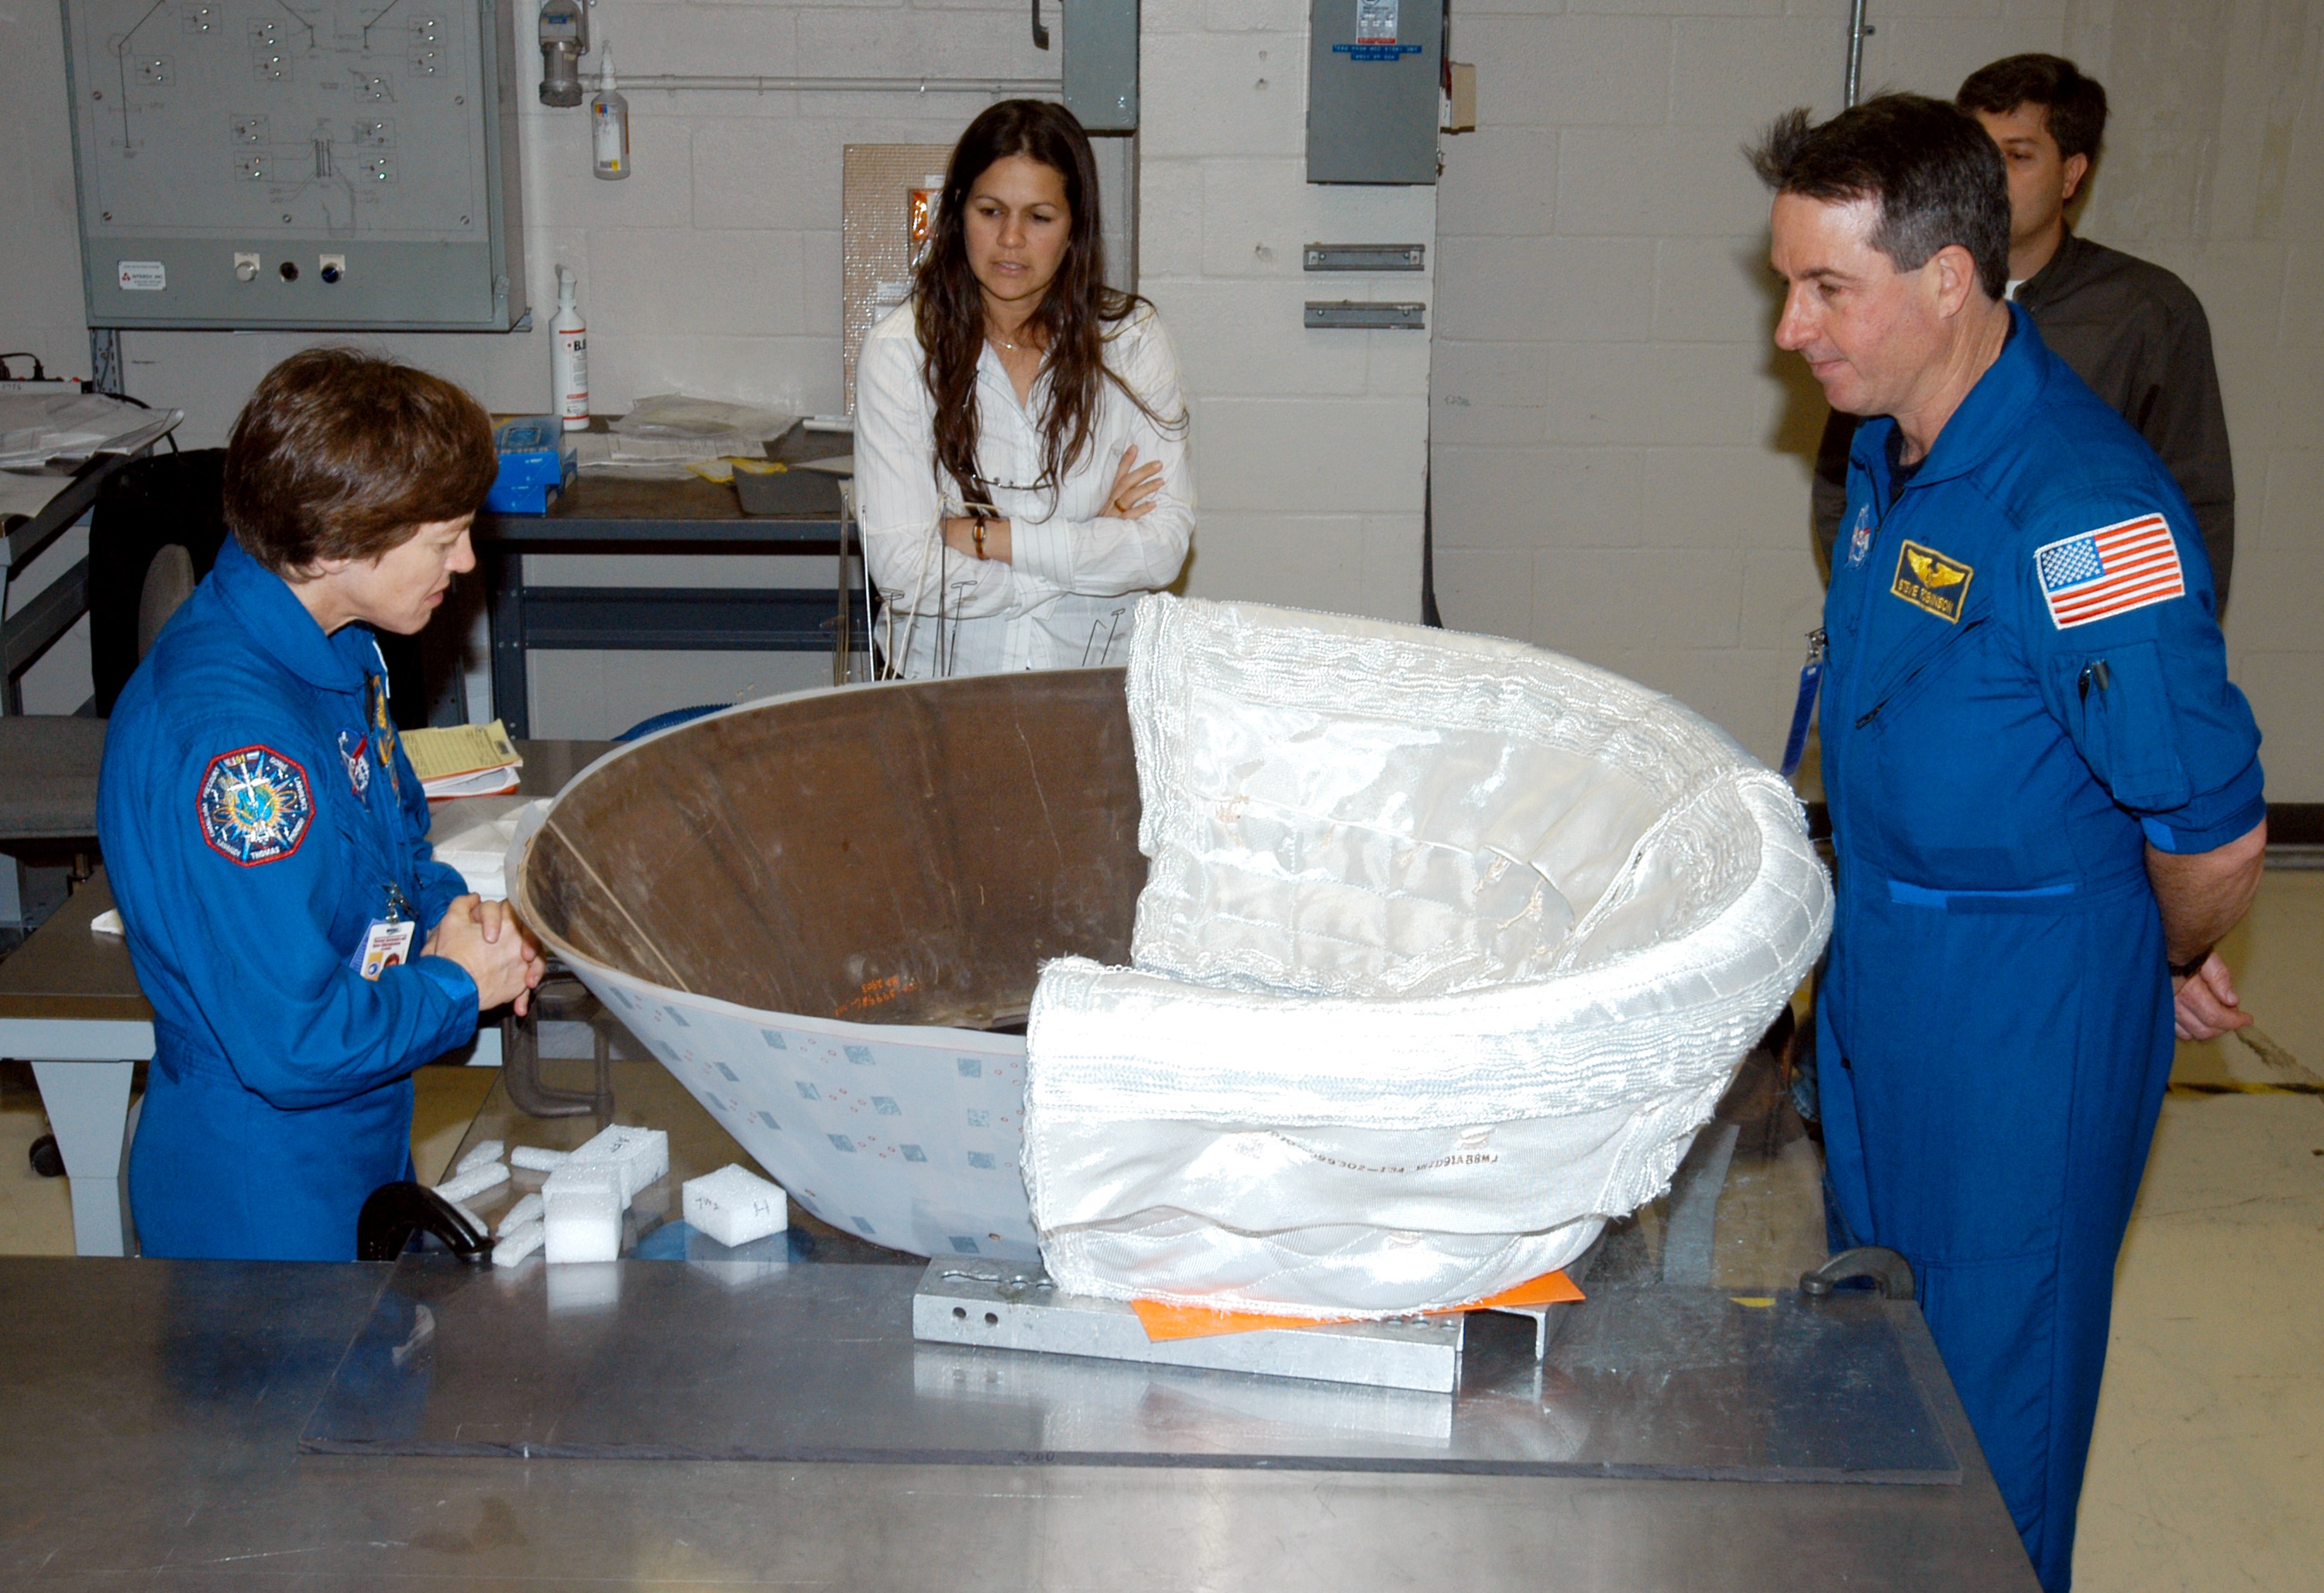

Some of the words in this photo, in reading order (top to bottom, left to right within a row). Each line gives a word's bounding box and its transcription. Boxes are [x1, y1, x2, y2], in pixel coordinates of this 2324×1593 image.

[1899, 578, 1920, 597] STEVE
[1920, 588, 1954, 615] ROBINSON
[250, 846, 280, 860] THOMAS
